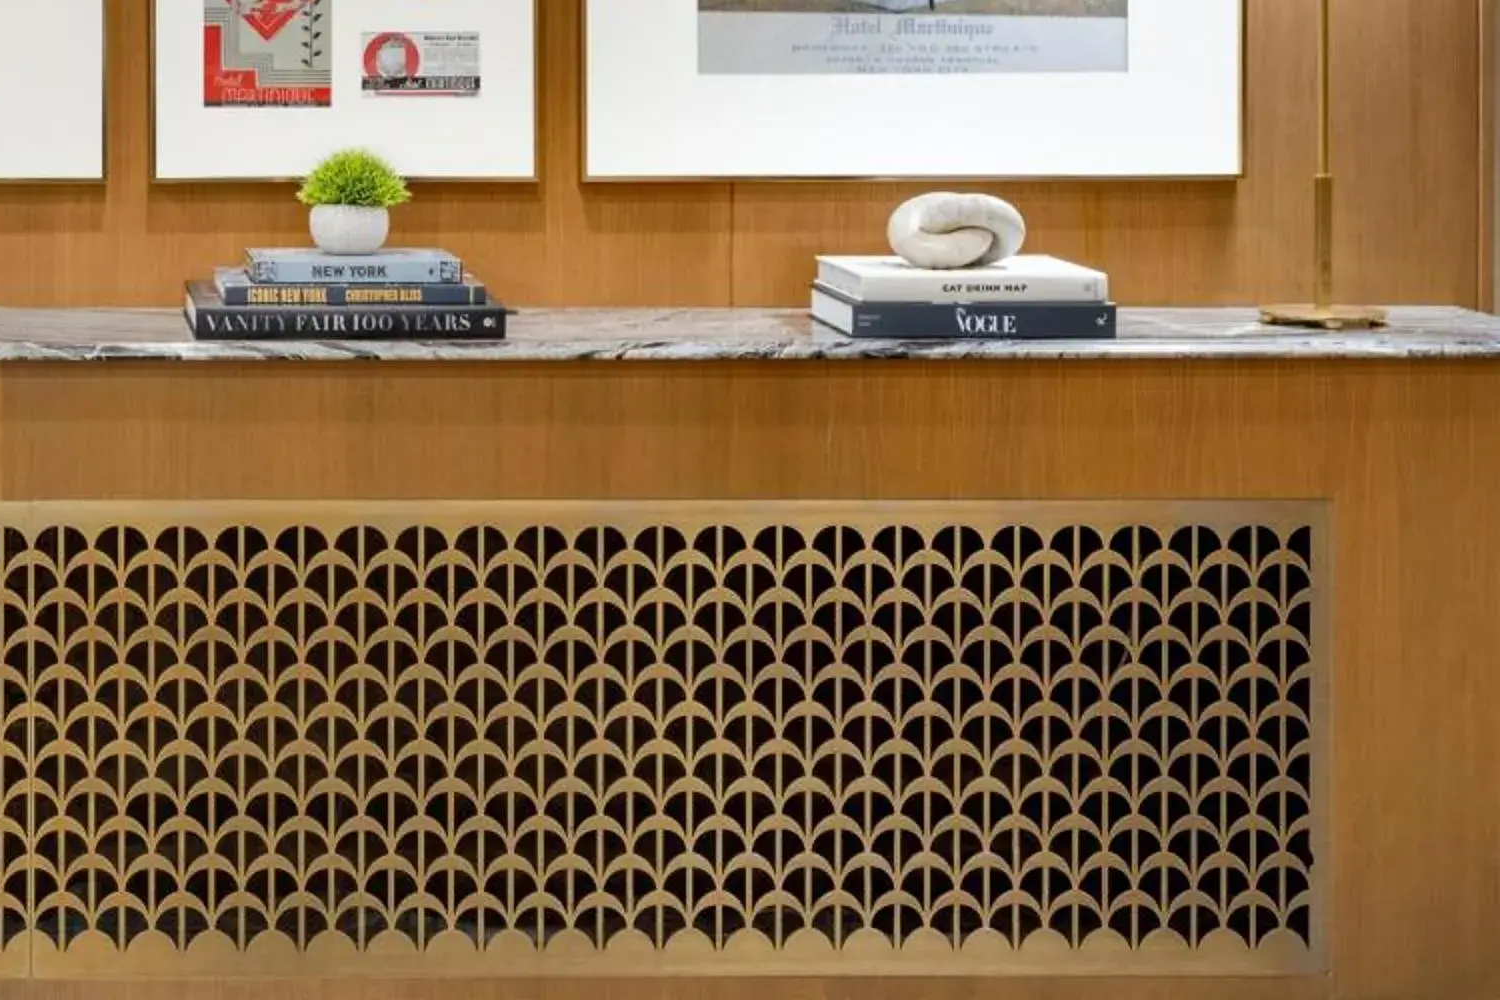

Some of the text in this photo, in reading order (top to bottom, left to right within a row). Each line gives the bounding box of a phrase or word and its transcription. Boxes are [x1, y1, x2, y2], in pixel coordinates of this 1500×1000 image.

[829, 16, 995, 41] Hotel Martinique
[311, 265, 388, 279] NEW YORK
[942, 284, 962, 293] EAT
[205, 313, 472, 333] VANITY FAIR 100 YEARS
[956, 306, 1017, 333] VOGUE
